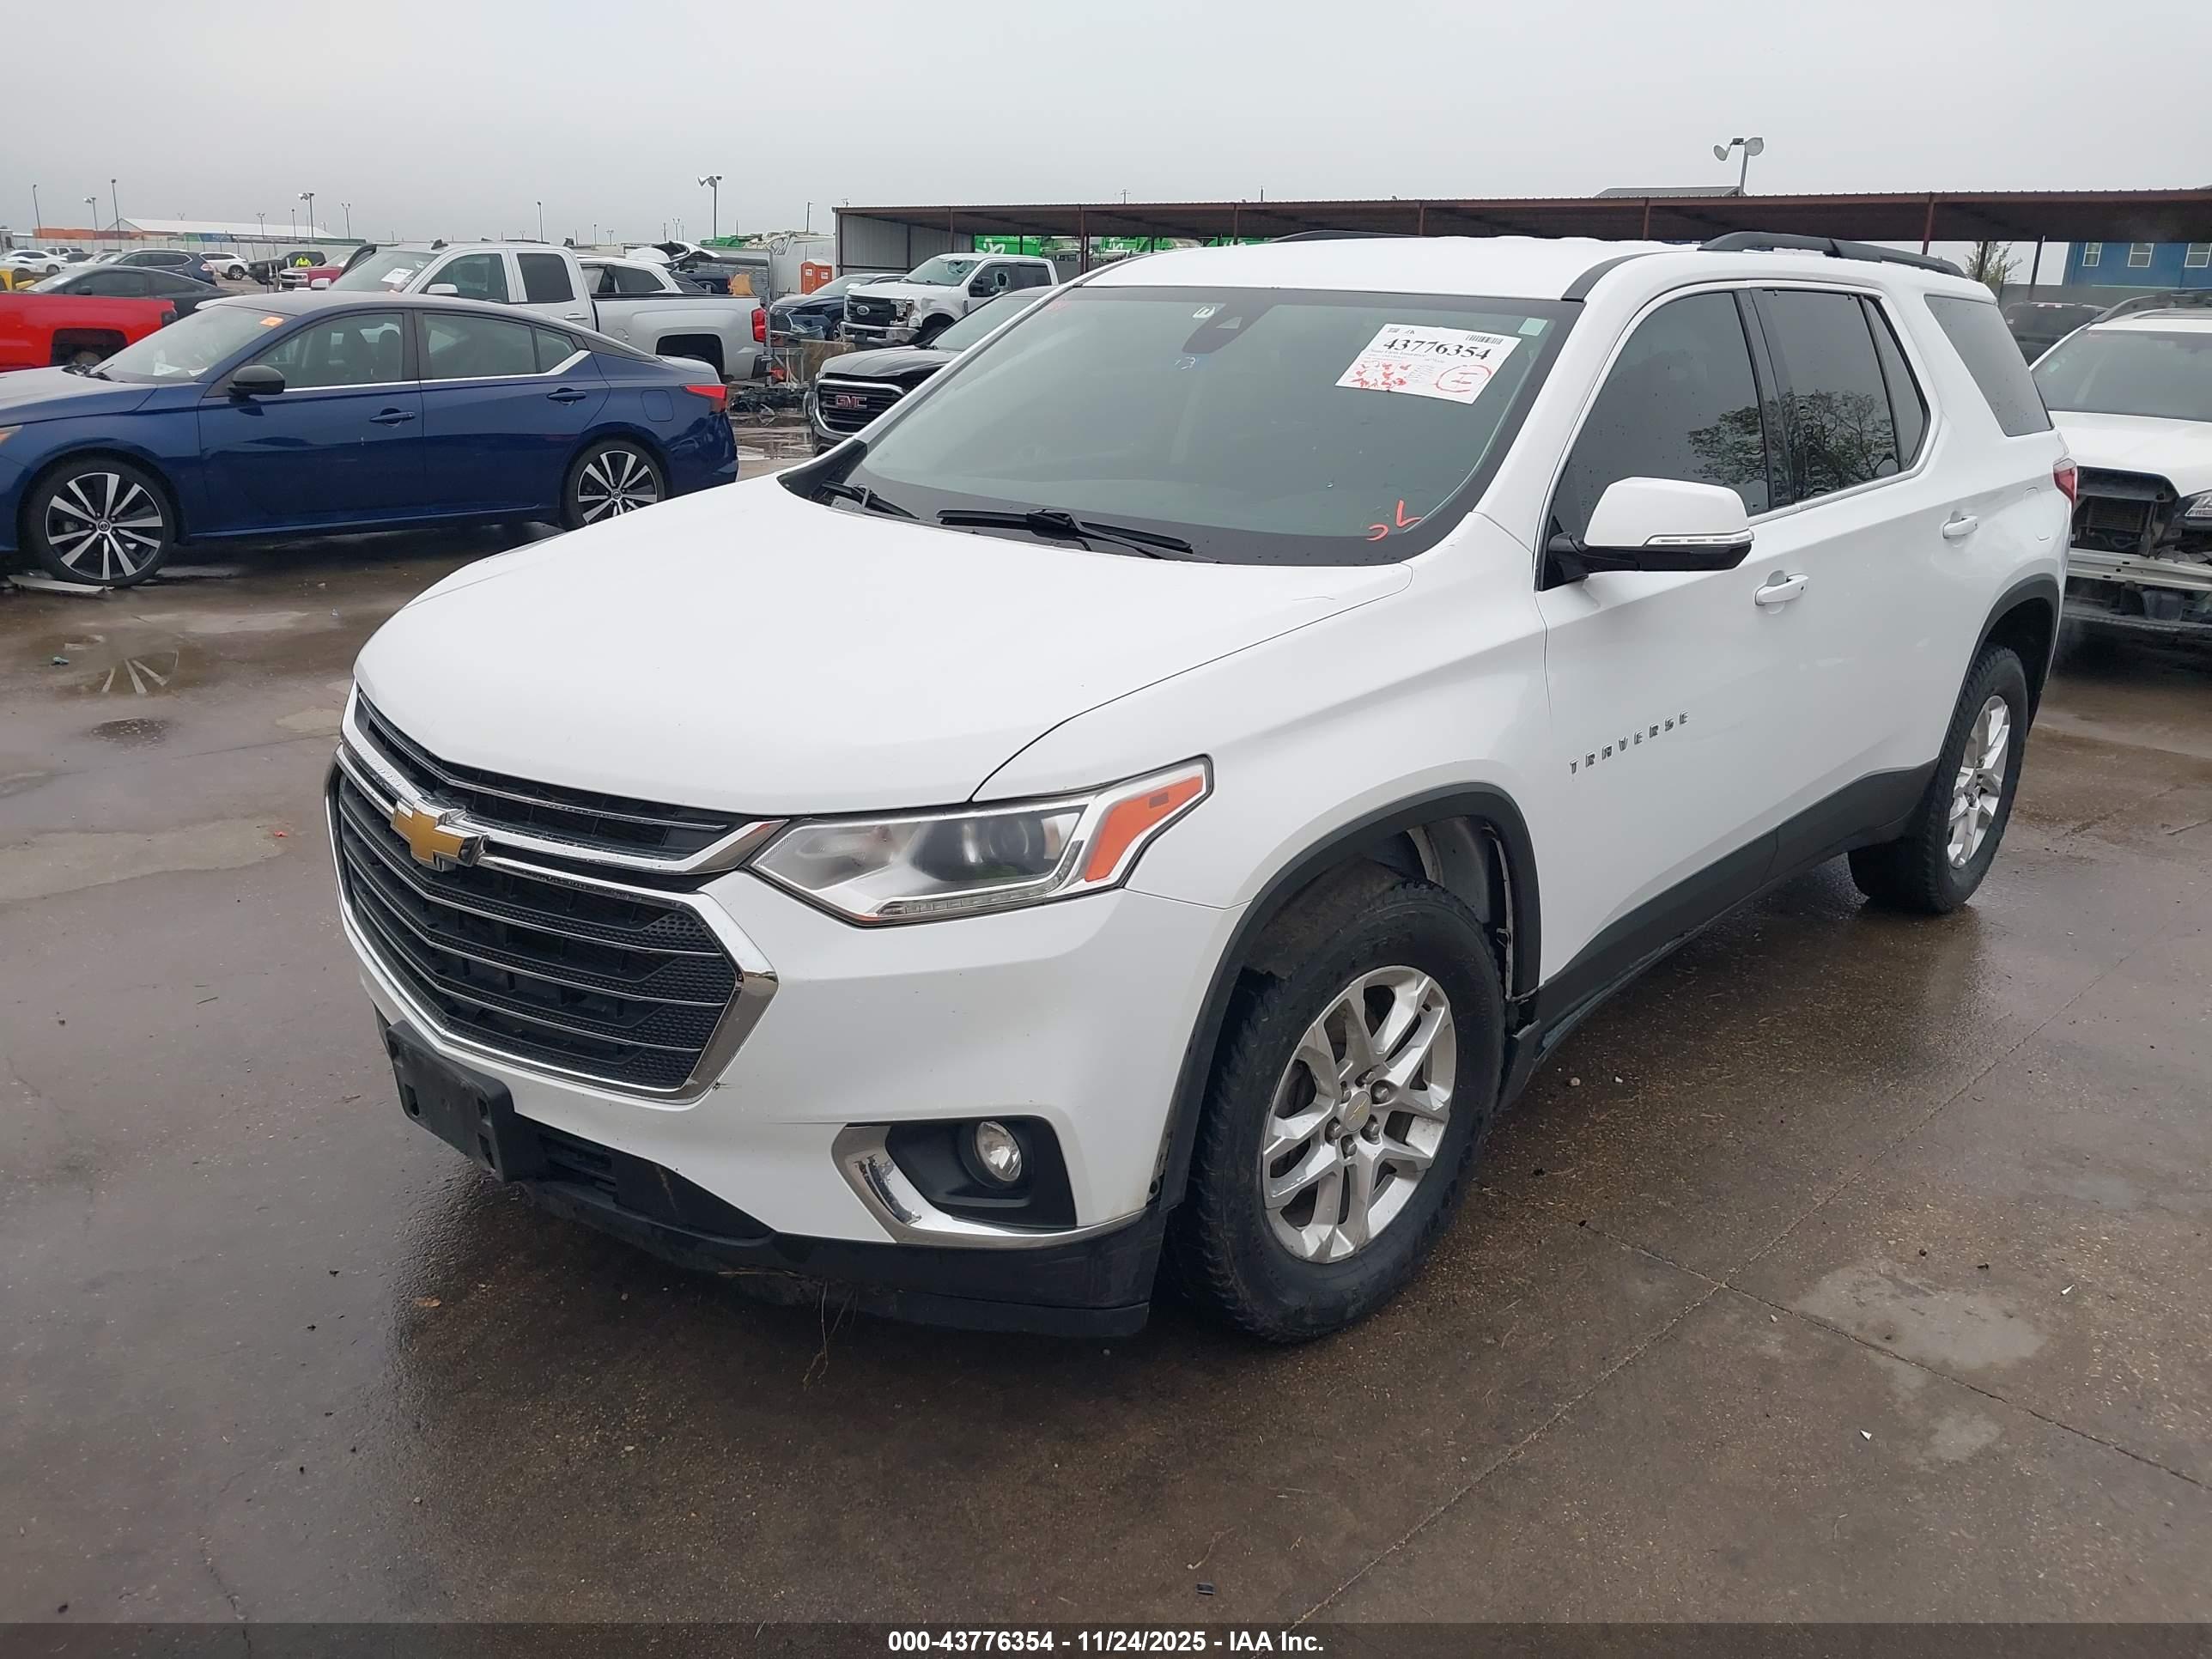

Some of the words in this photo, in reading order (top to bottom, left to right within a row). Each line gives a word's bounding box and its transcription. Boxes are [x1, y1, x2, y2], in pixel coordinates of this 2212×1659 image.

[1383, 338, 1492, 360] 43776354
[836, 395, 867, 410] GMC
[1570, 711, 1689, 775] TRAVERSE
